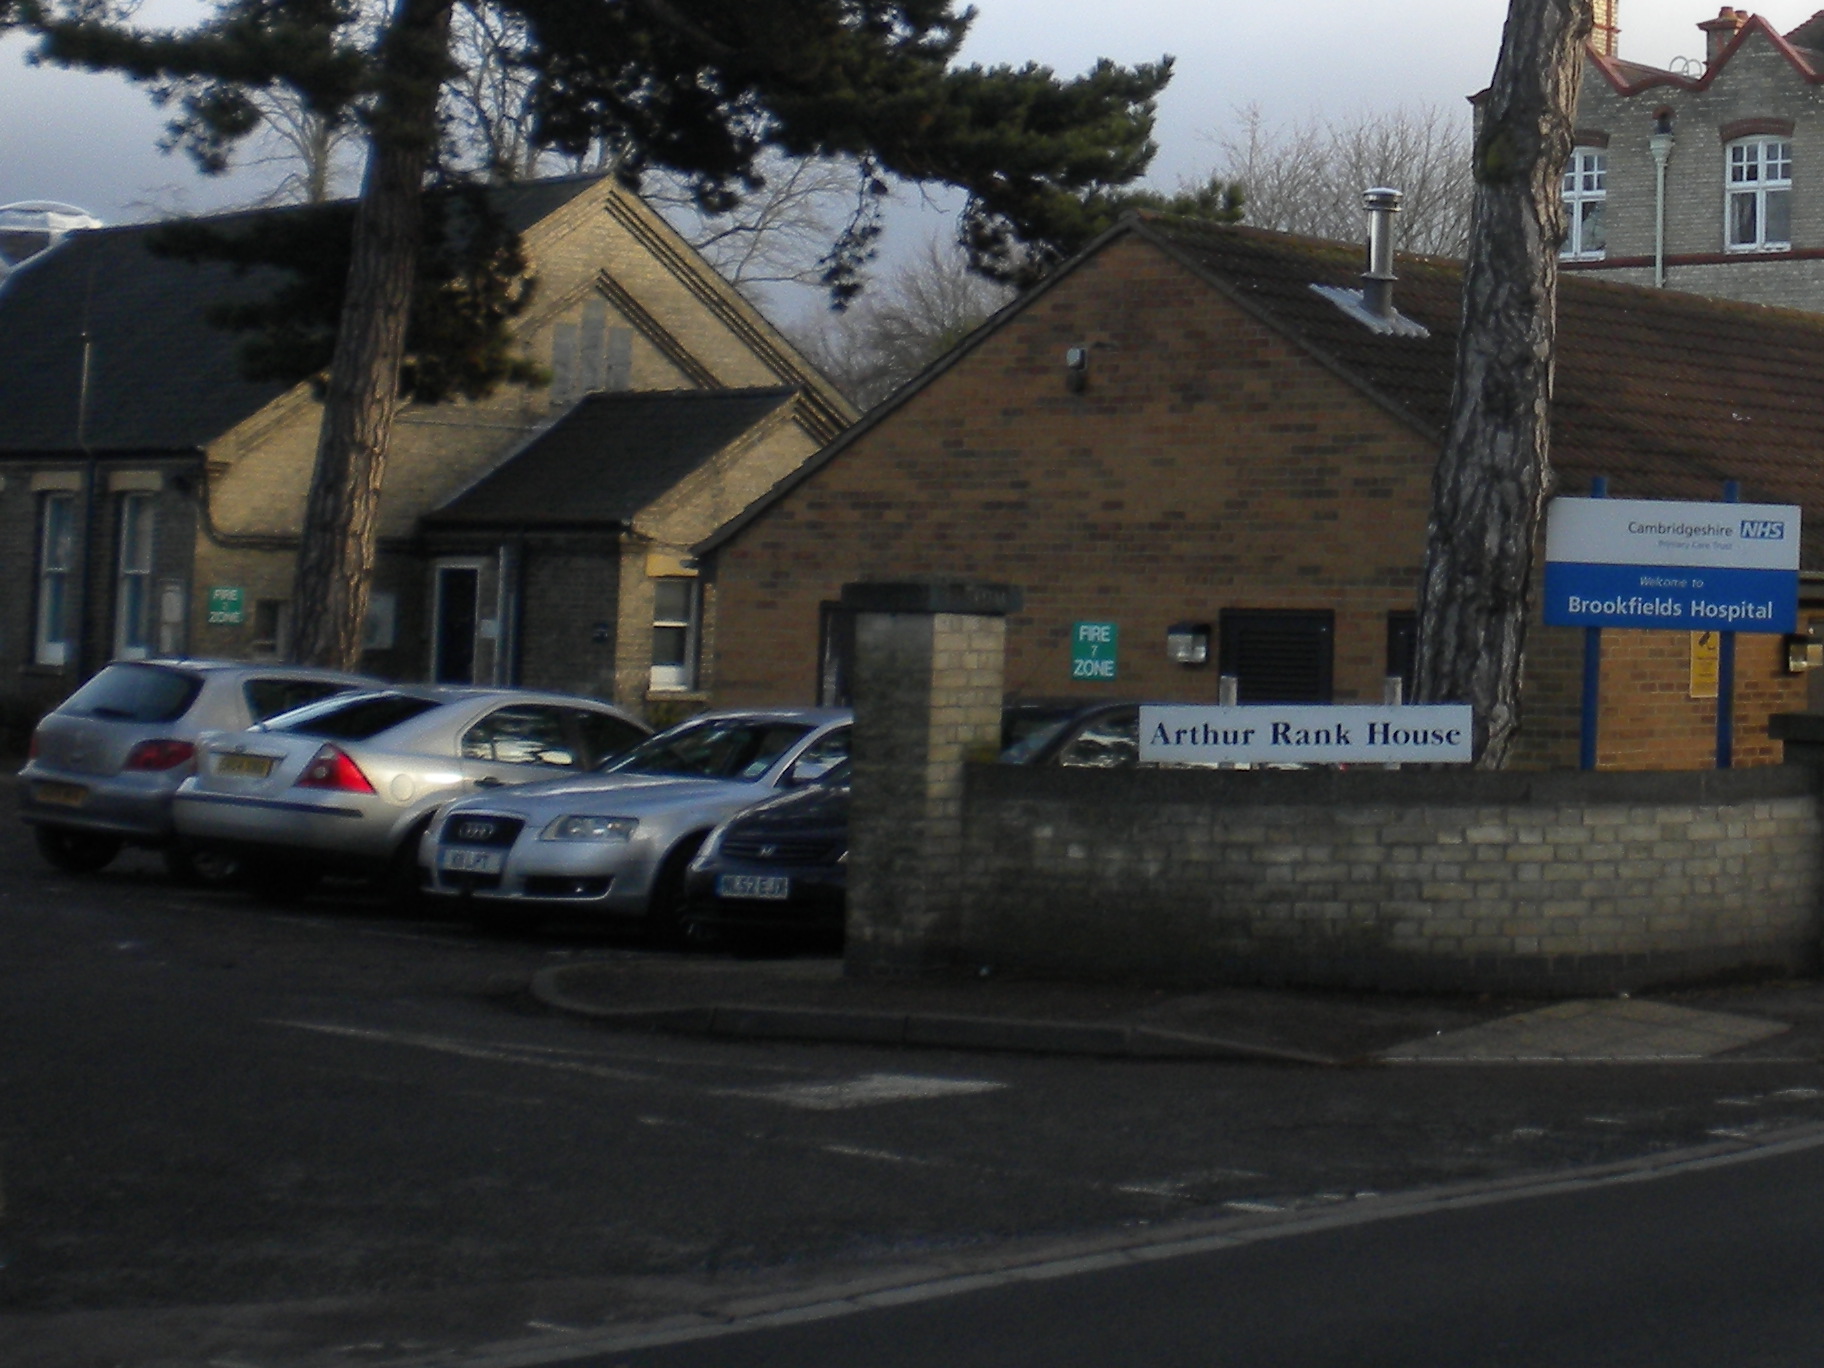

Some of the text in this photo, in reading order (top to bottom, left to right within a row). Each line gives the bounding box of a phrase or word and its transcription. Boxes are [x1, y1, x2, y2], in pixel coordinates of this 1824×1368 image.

[1627, 520, 1733, 539] Cambridgeshire
[1742, 521, 1784, 539] NHS
[1639, 575, 1704, 589] Welcome to
[208, 611, 241, 623] ZONE
[1567, 595, 1773, 622] Brookfields Hospital
[1079, 625, 1111, 642] FIRE
[1090, 645, 1098, 657] 7
[1072, 659, 1115, 677] ZONE
[1150, 721, 1462, 747] Arthur Rank House
